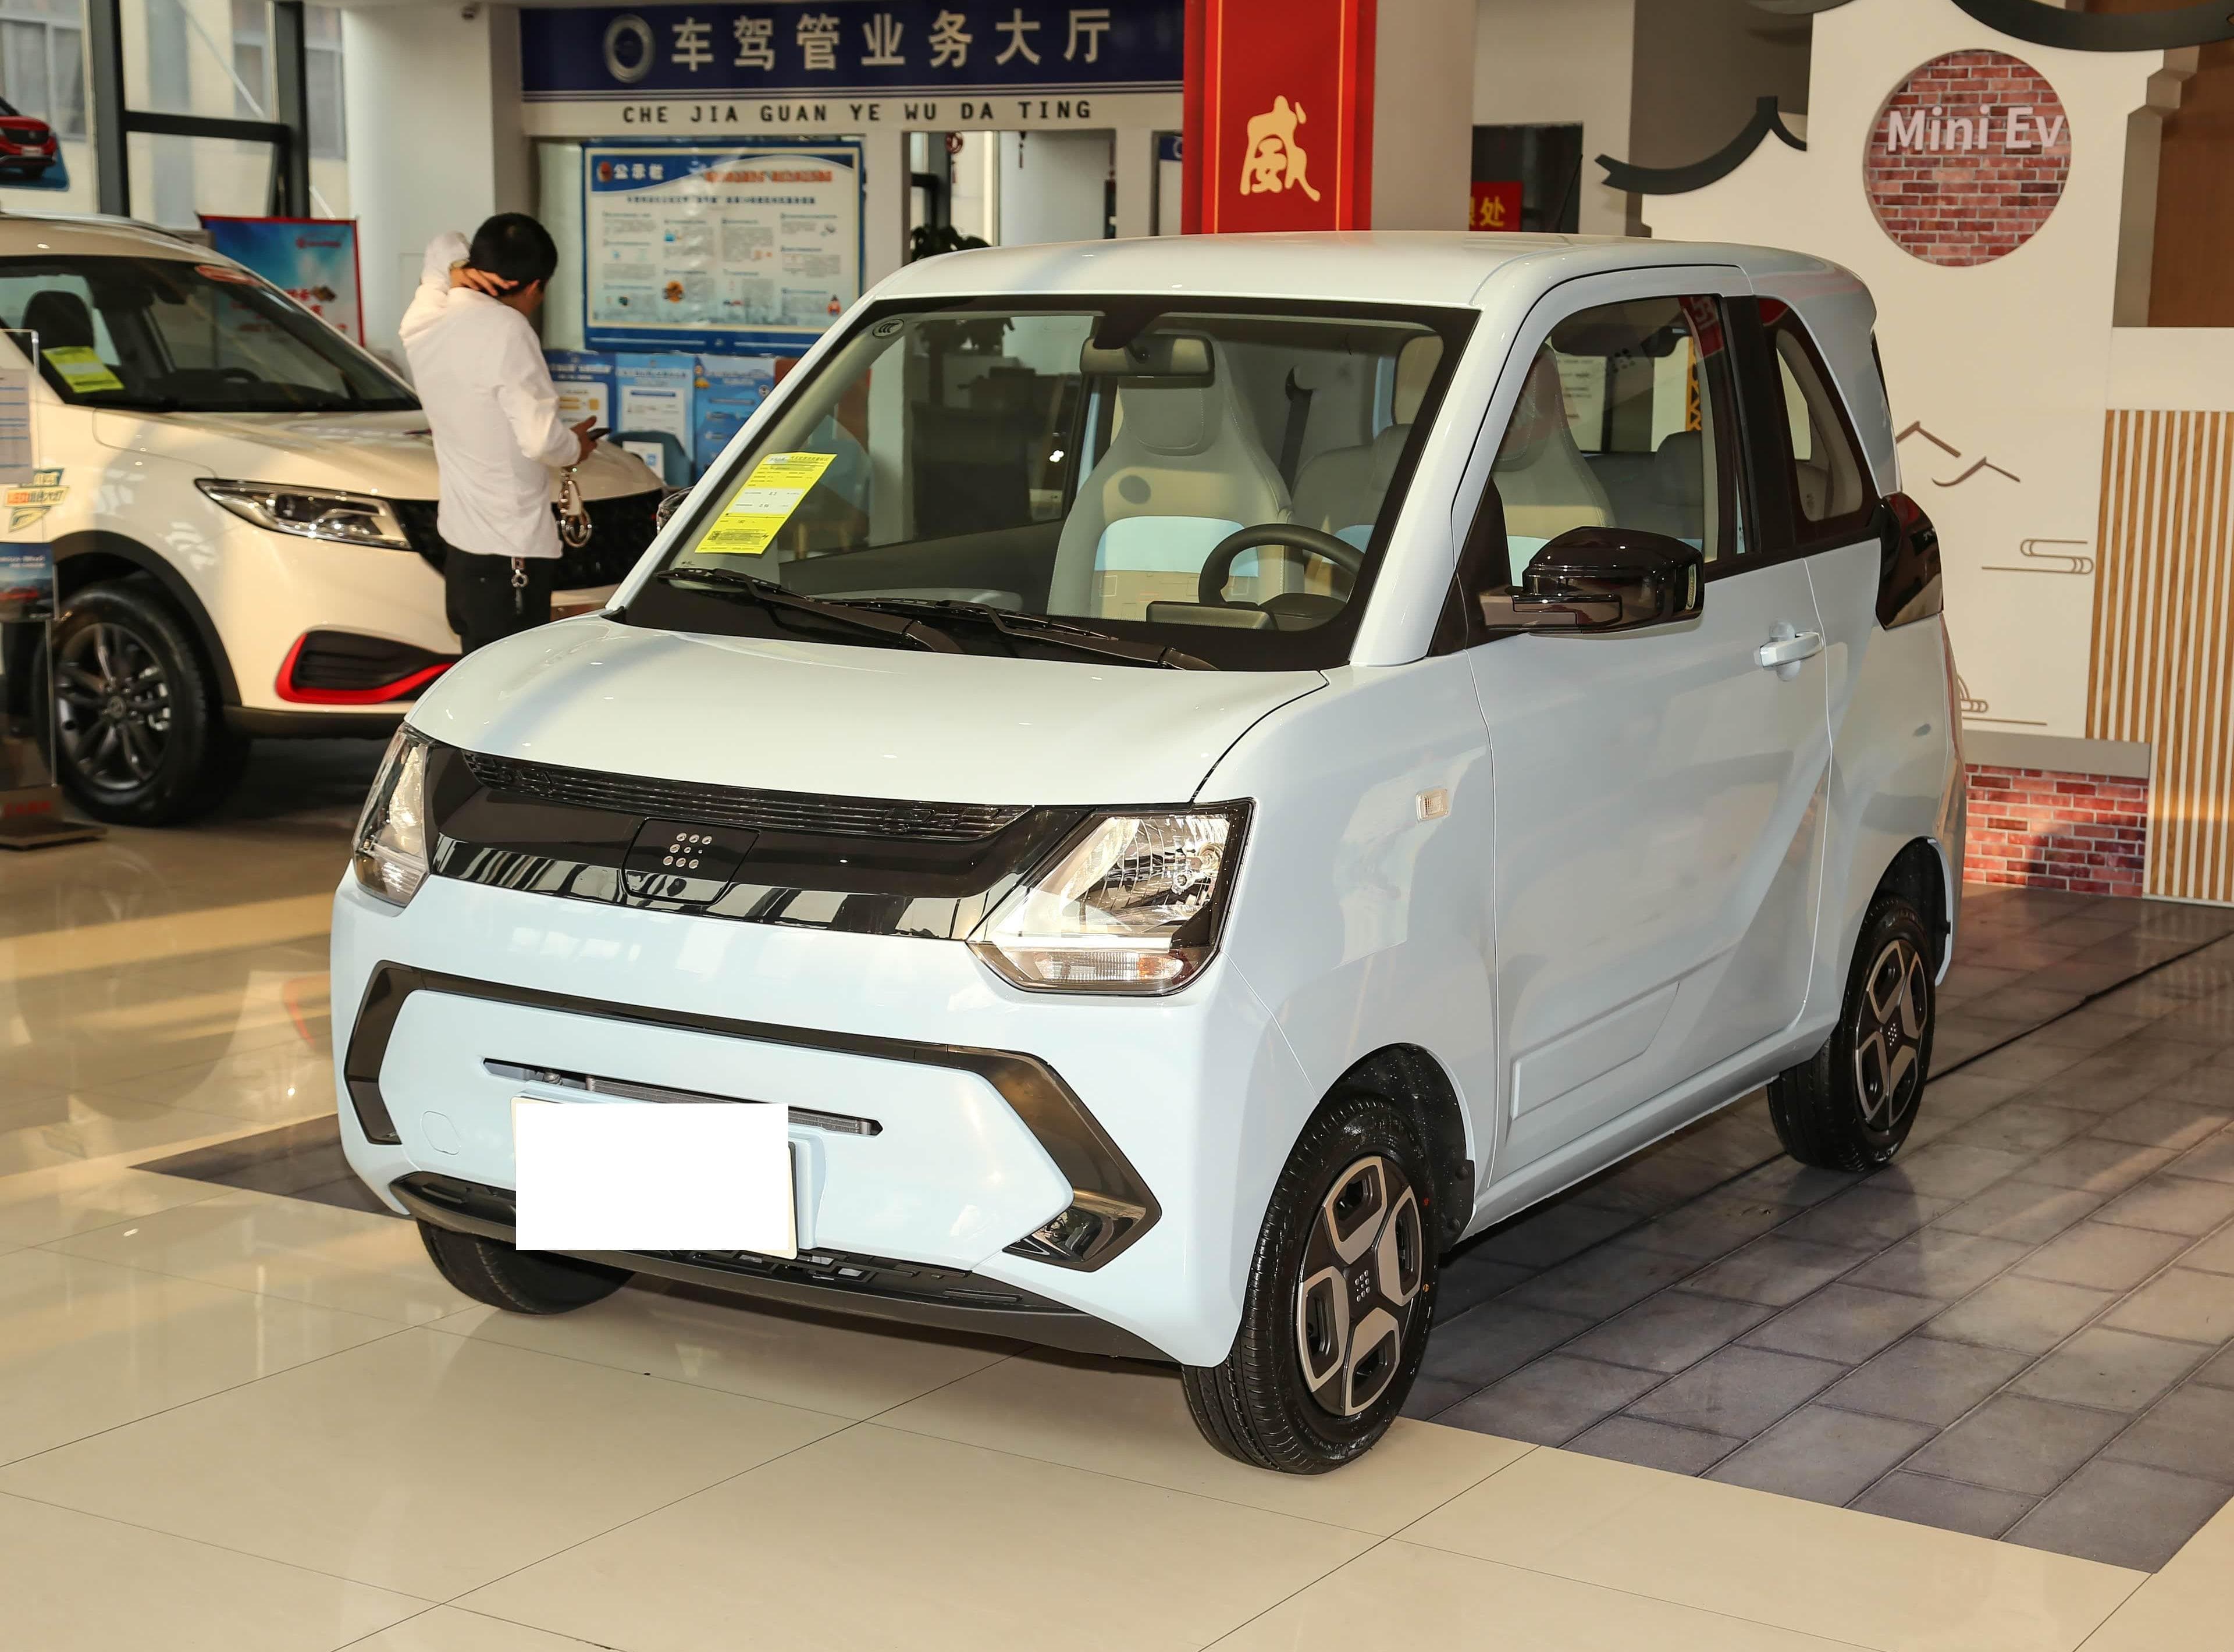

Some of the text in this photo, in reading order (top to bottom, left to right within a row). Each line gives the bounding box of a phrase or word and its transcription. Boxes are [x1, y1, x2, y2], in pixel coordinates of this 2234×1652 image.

[671, 8, 1111, 72] 车驾管业务大厅
[623, 100, 1091, 123] CHE JIA GUAN YE WU DA TING
[1887, 103, 2065, 152] Mini Ev
[1470, 195, 1506, 227] 处
